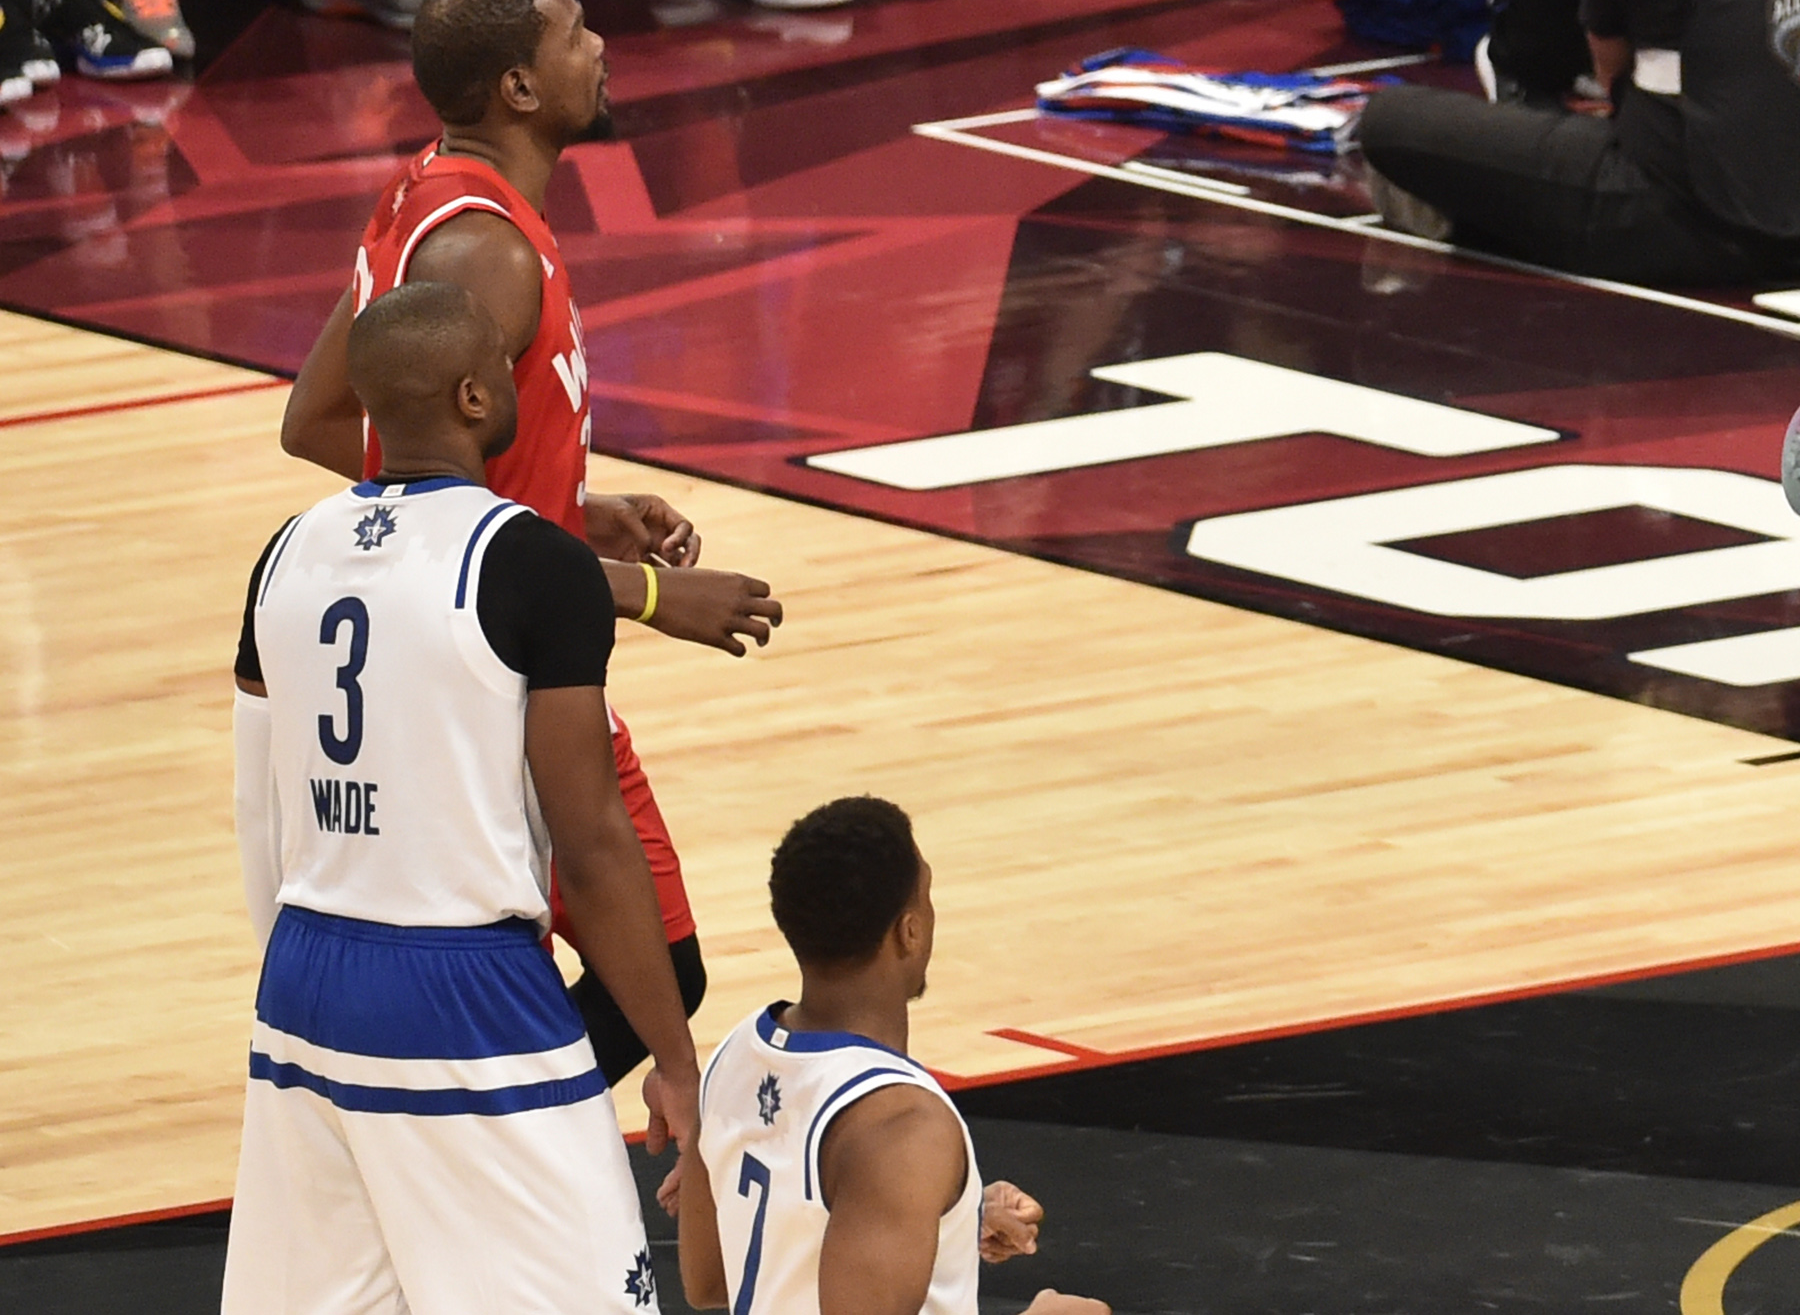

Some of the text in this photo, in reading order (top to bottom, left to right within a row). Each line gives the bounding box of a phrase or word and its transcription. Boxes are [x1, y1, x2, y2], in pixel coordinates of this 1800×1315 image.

[318, 596, 370, 766] 3
[310, 778, 381, 837] WADE
[737, 1150, 771, 1315] 7
